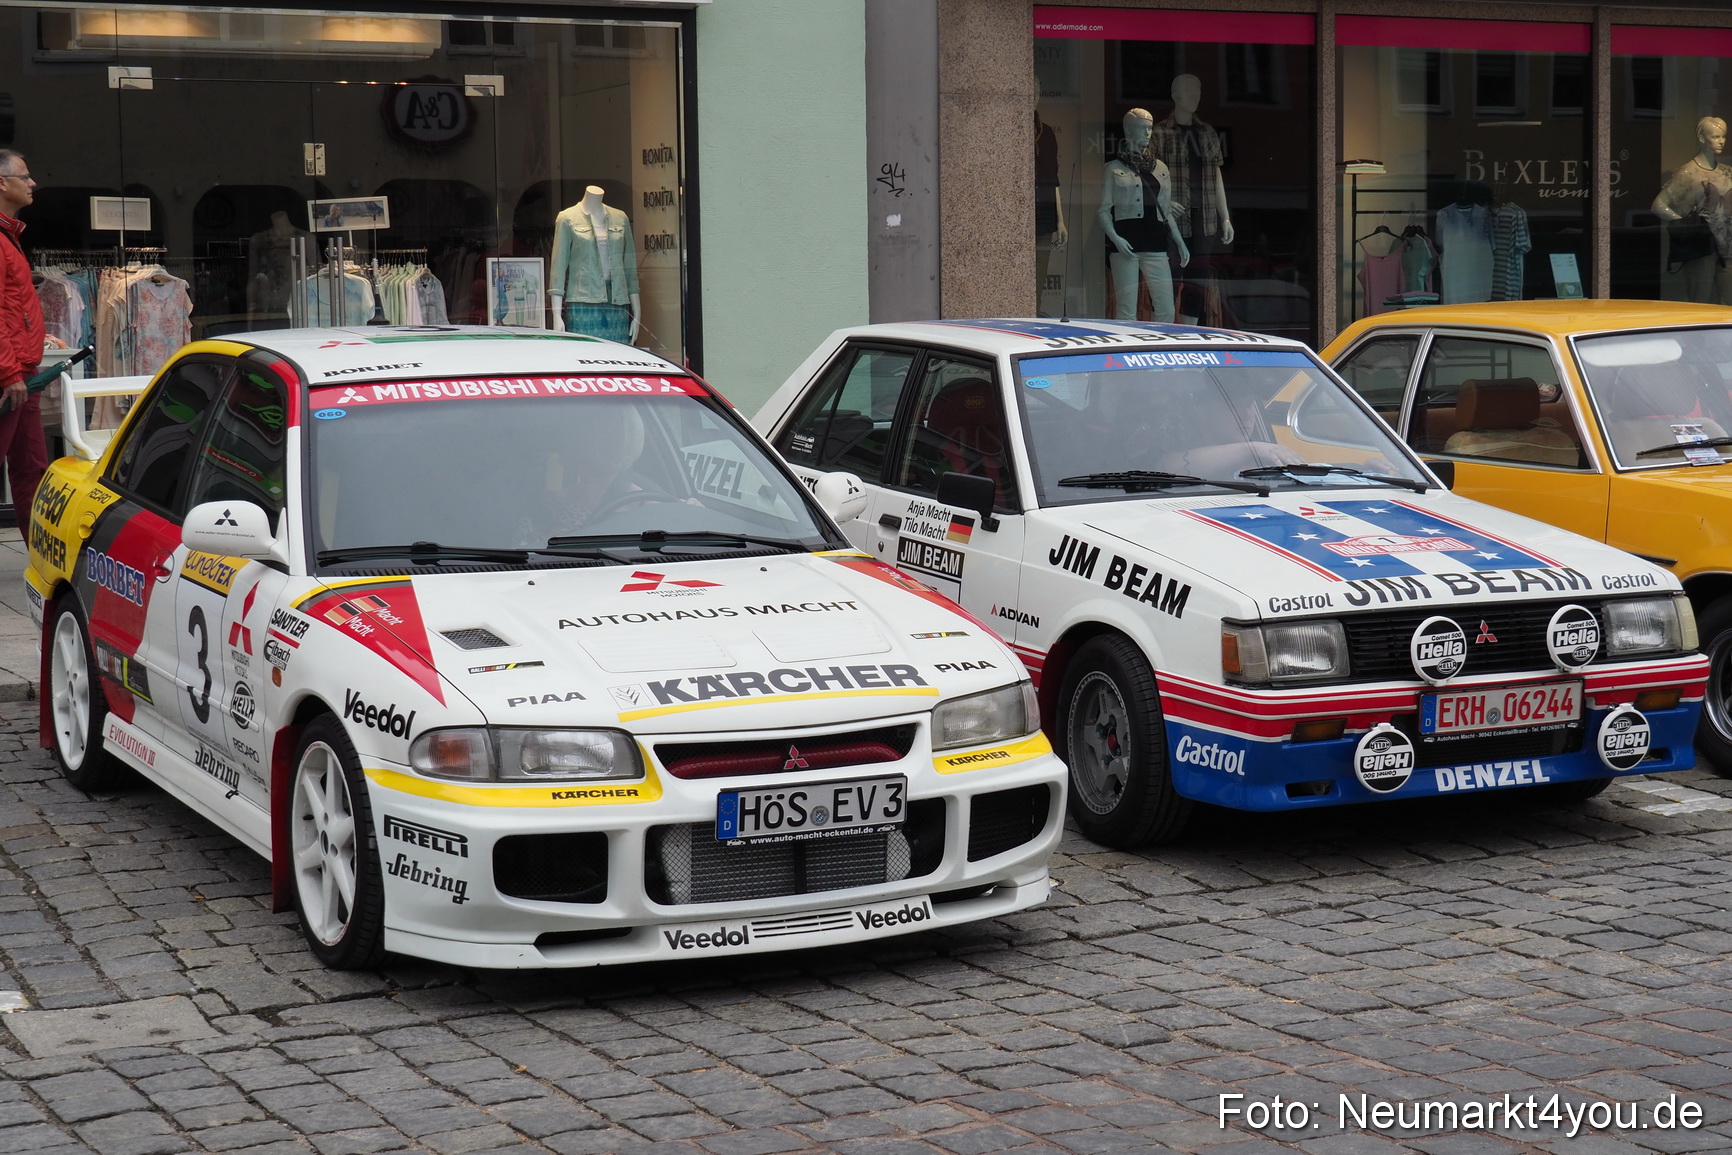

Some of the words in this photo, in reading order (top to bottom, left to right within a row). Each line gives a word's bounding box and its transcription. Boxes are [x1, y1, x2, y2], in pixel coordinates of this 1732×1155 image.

[1035, 23, 1104, 31] www.adlermode.com
[642, 147, 675, 165] BONITA
[643, 190, 675, 208] BONITA
[1537, 187, 1629, 198] womn
[644, 234, 676, 251] BONITA
[1044, 335, 1123, 348] JIM
[1129, 333, 1270, 343] BEAM
[323, 362, 423, 377] BORBET
[577, 359, 668, 369] BORBET
[1123, 353, 1220, 367] MITSUBISHI
[372, 379, 538, 400] MITSUBISHI
[541, 377, 653, 394] MOTORS
[684, 452, 745, 500] ENZEL
[34, 471, 76, 528] Veedol
[907, 500, 925, 518] Anja
[926, 504, 951, 522] Macht
[903, 517, 918, 532] Tilo
[920, 523, 946, 541] Macht
[900, 540, 923, 564] JIM
[924, 545, 961, 576] BEAM
[86, 546, 146, 608] BORBET
[1048, 534, 1101, 580] JIM
[1103, 554, 1192, 620] BEAM
[646, 588, 707, 596] MITSUBISHI
[1269, 593, 1334, 614] Castrol
[1343, 576, 1433, 607] JIM
[1433, 567, 1593, 596] BEAM
[1602, 572, 1658, 591] Castrol
[373, 607, 404, 626] Macht
[558, 607, 739, 630] AUTOHAUS
[744, 600, 859, 616] MACHT
[999, 606, 1040, 628] ADVAN
[346, 616, 375, 637] Macht
[1555, 628, 1596, 647] Hella
[264, 640, 291, 664] Eibach
[1420, 640, 1463, 659] Hella
[187, 605, 211, 724] 3
[934, 660, 998, 673] PIAA
[1439, 661, 1457, 669] HELLA
[647, 664, 929, 705] KÄRCHER
[507, 691, 587, 708] PIAA
[1425, 718, 1432, 727] D
[1438, 695, 1486, 728] ERH
[1504, 687, 1574, 722] 06244
[344, 688, 416, 740] Veedol
[109, 724, 148, 763] EVOLUTION
[147, 751, 157, 767] III
[232, 737, 260, 763] RECARO
[1605, 732, 1647, 749] Hella
[945, 750, 1011, 766] KÄRCHER
[1175, 735, 1246, 776] Castrol
[1362, 752, 1410, 771] Hella
[1434, 759, 1550, 792] DENZEL
[551, 788, 639, 800] KÄRCHER
[723, 820, 732, 831] D
[833, 785, 877, 823] EV
[883, 782, 903, 818] 3
[384, 814, 468, 858] PIRELLI
[750, 827, 874, 845] www.auto-macht-eckental.de
[386, 853, 470, 904] Sebring
[663, 925, 750, 950] Veedol
[855, 901, 931, 930] Veedol
